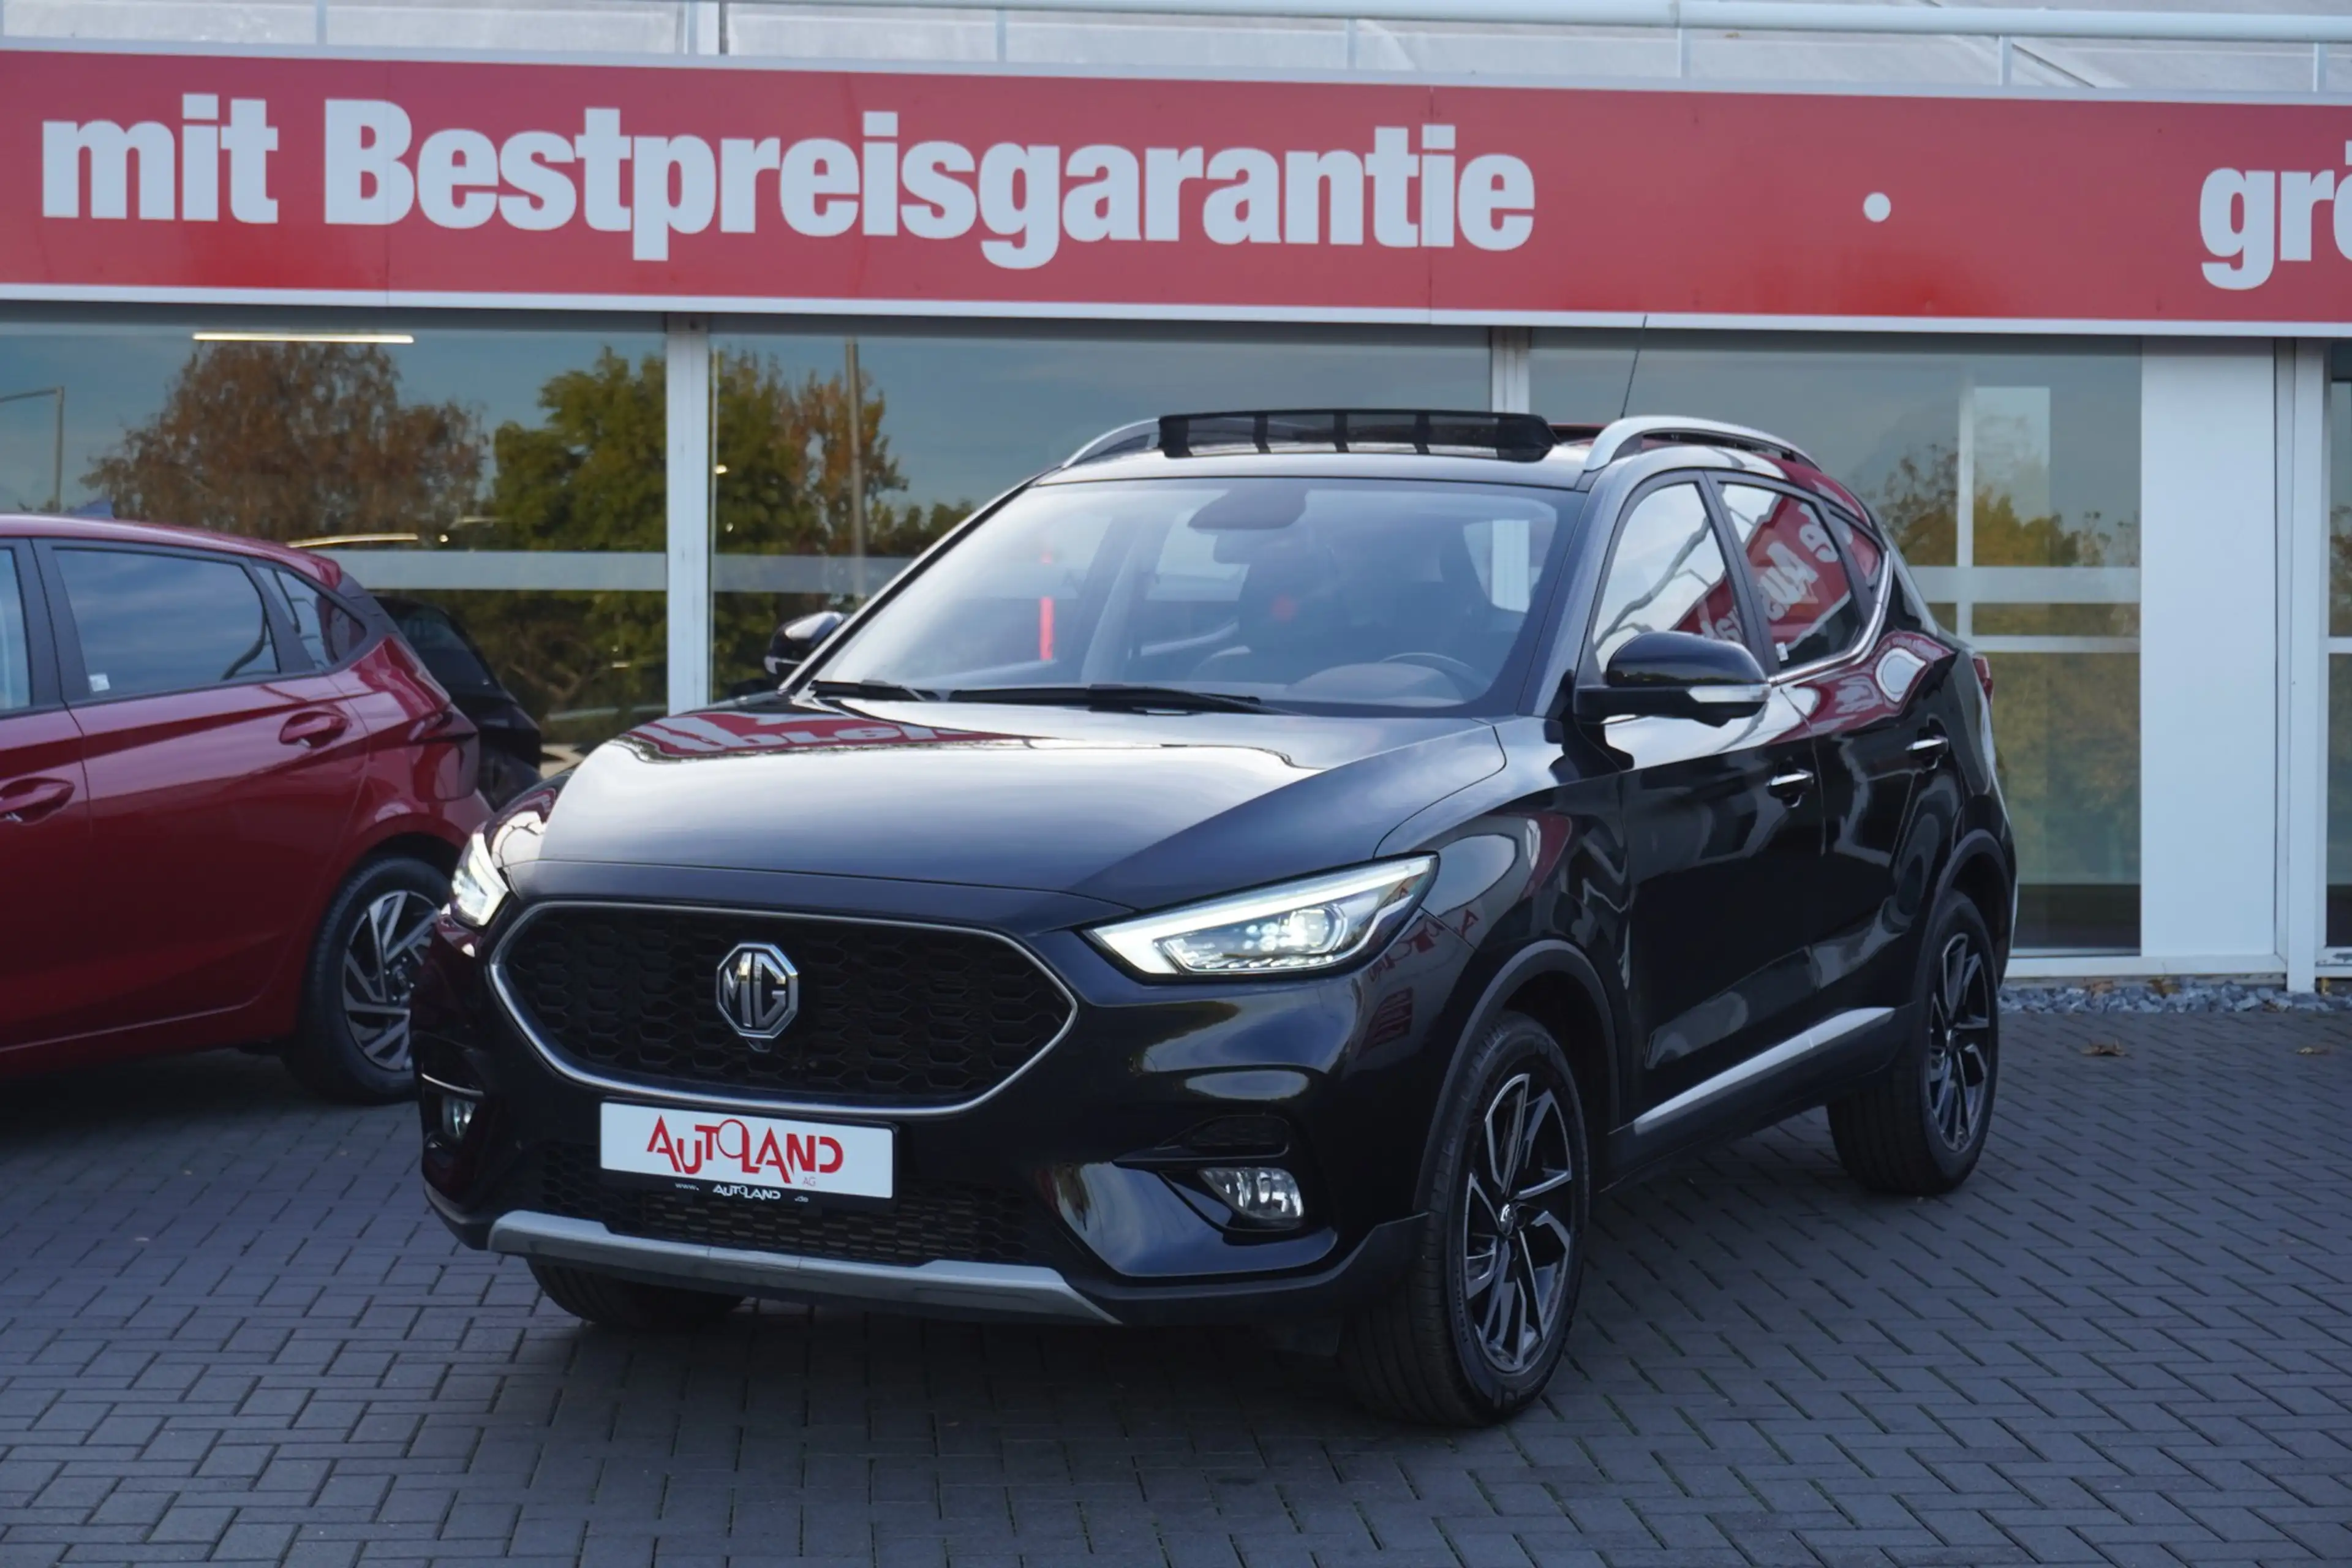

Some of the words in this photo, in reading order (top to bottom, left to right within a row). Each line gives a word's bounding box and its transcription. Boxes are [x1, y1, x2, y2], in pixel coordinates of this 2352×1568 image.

[42, 94, 278, 224] mit
[325, 99, 1536, 270] Bestpreisgarantie
[2199, 140, 2352, 290] gr
[722, 951, 786, 1028] MG
[802, 1176, 816, 1187] AG
